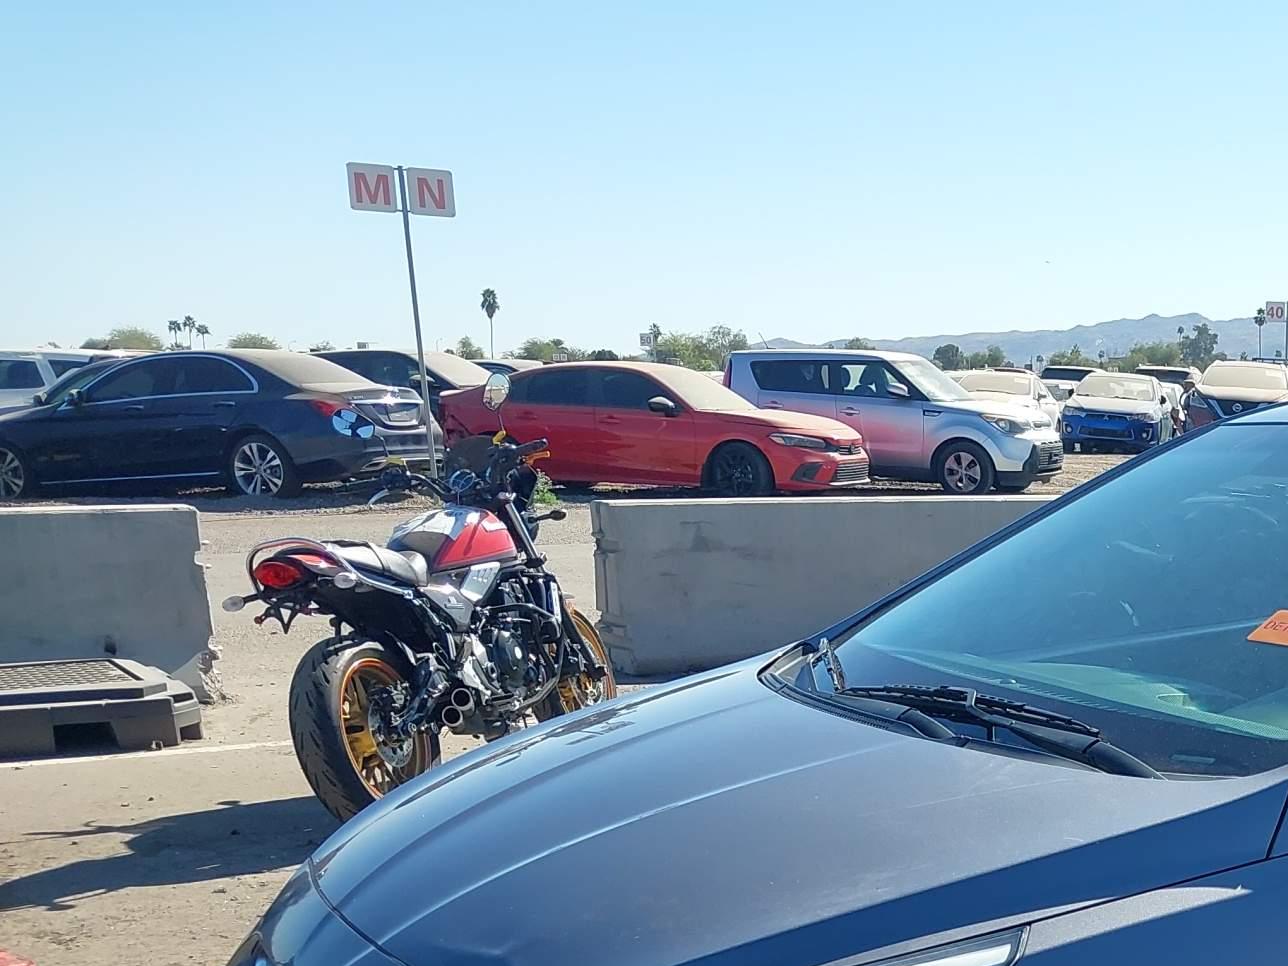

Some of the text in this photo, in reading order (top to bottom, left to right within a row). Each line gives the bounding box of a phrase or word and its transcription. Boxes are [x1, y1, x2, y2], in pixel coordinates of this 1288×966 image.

[353, 172, 446, 209] M N
[1267, 306, 1284, 319] 40
[640, 336, 652, 345] 50
